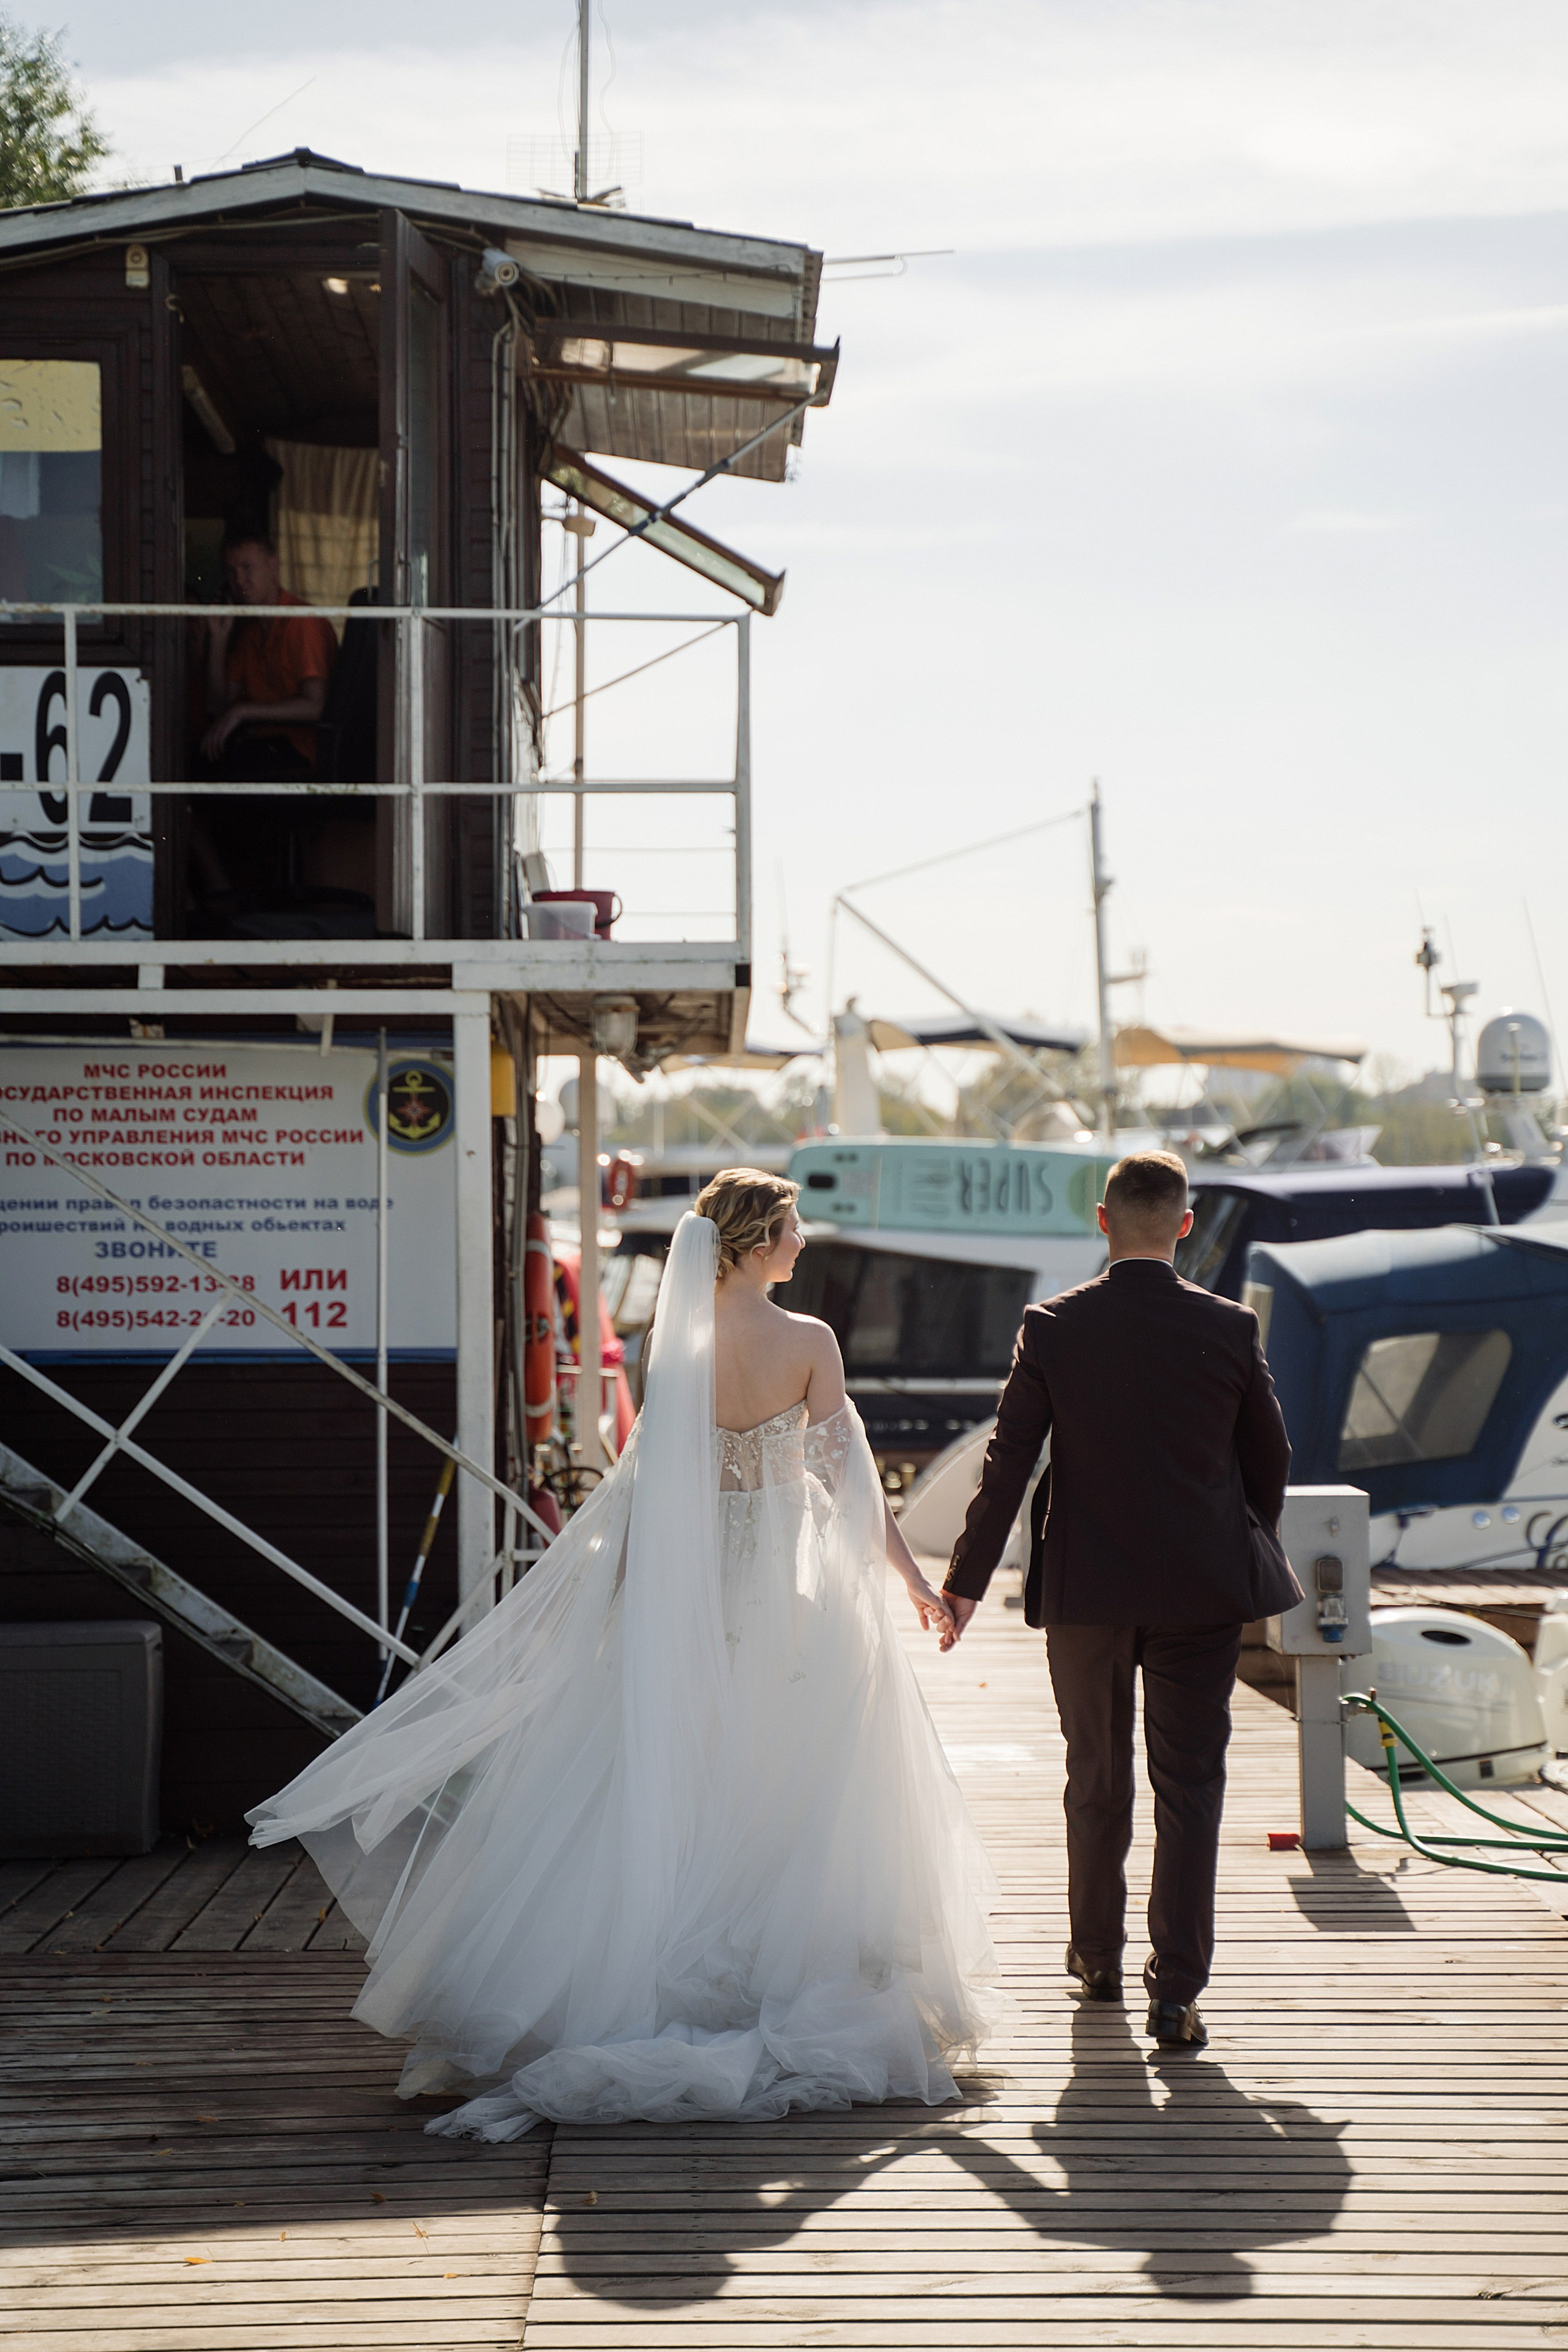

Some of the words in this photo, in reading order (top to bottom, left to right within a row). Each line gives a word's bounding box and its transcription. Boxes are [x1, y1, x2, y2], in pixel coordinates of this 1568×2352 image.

[83, 1063, 130, 1079] МЧС
[137, 1063, 227, 1079] РОССИИ
[0, 1085, 192, 1102] СУДАРСТВЕННАЯ
[200, 1085, 333, 1102] ИНСПЕКЦИЯ
[53, 1107, 83, 1122] ПО
[91, 1107, 175, 1122] МАЛЫМ
[183, 1107, 258, 1124] СУДАМ
[69, 1129, 214, 1145] УПРАВЛЕНИЯ
[222, 1129, 268, 1144] МЧС
[276, 1129, 364, 1144] РОССИИ
[6, 1152, 36, 1166] ПО
[202, 1152, 305, 1166] ОБЛАСТИ
[957, 1156, 1054, 1216] SUPER
[148, 1194, 306, 1210] безопастности
[314, 1198, 339, 1210] на
[165, 1220, 244, 1234] водных
[280, 1268, 348, 1291] ИЛИ
[56, 1310, 255, 1332] 8(495)542-2-20
[281, 1300, 348, 1328] 112
